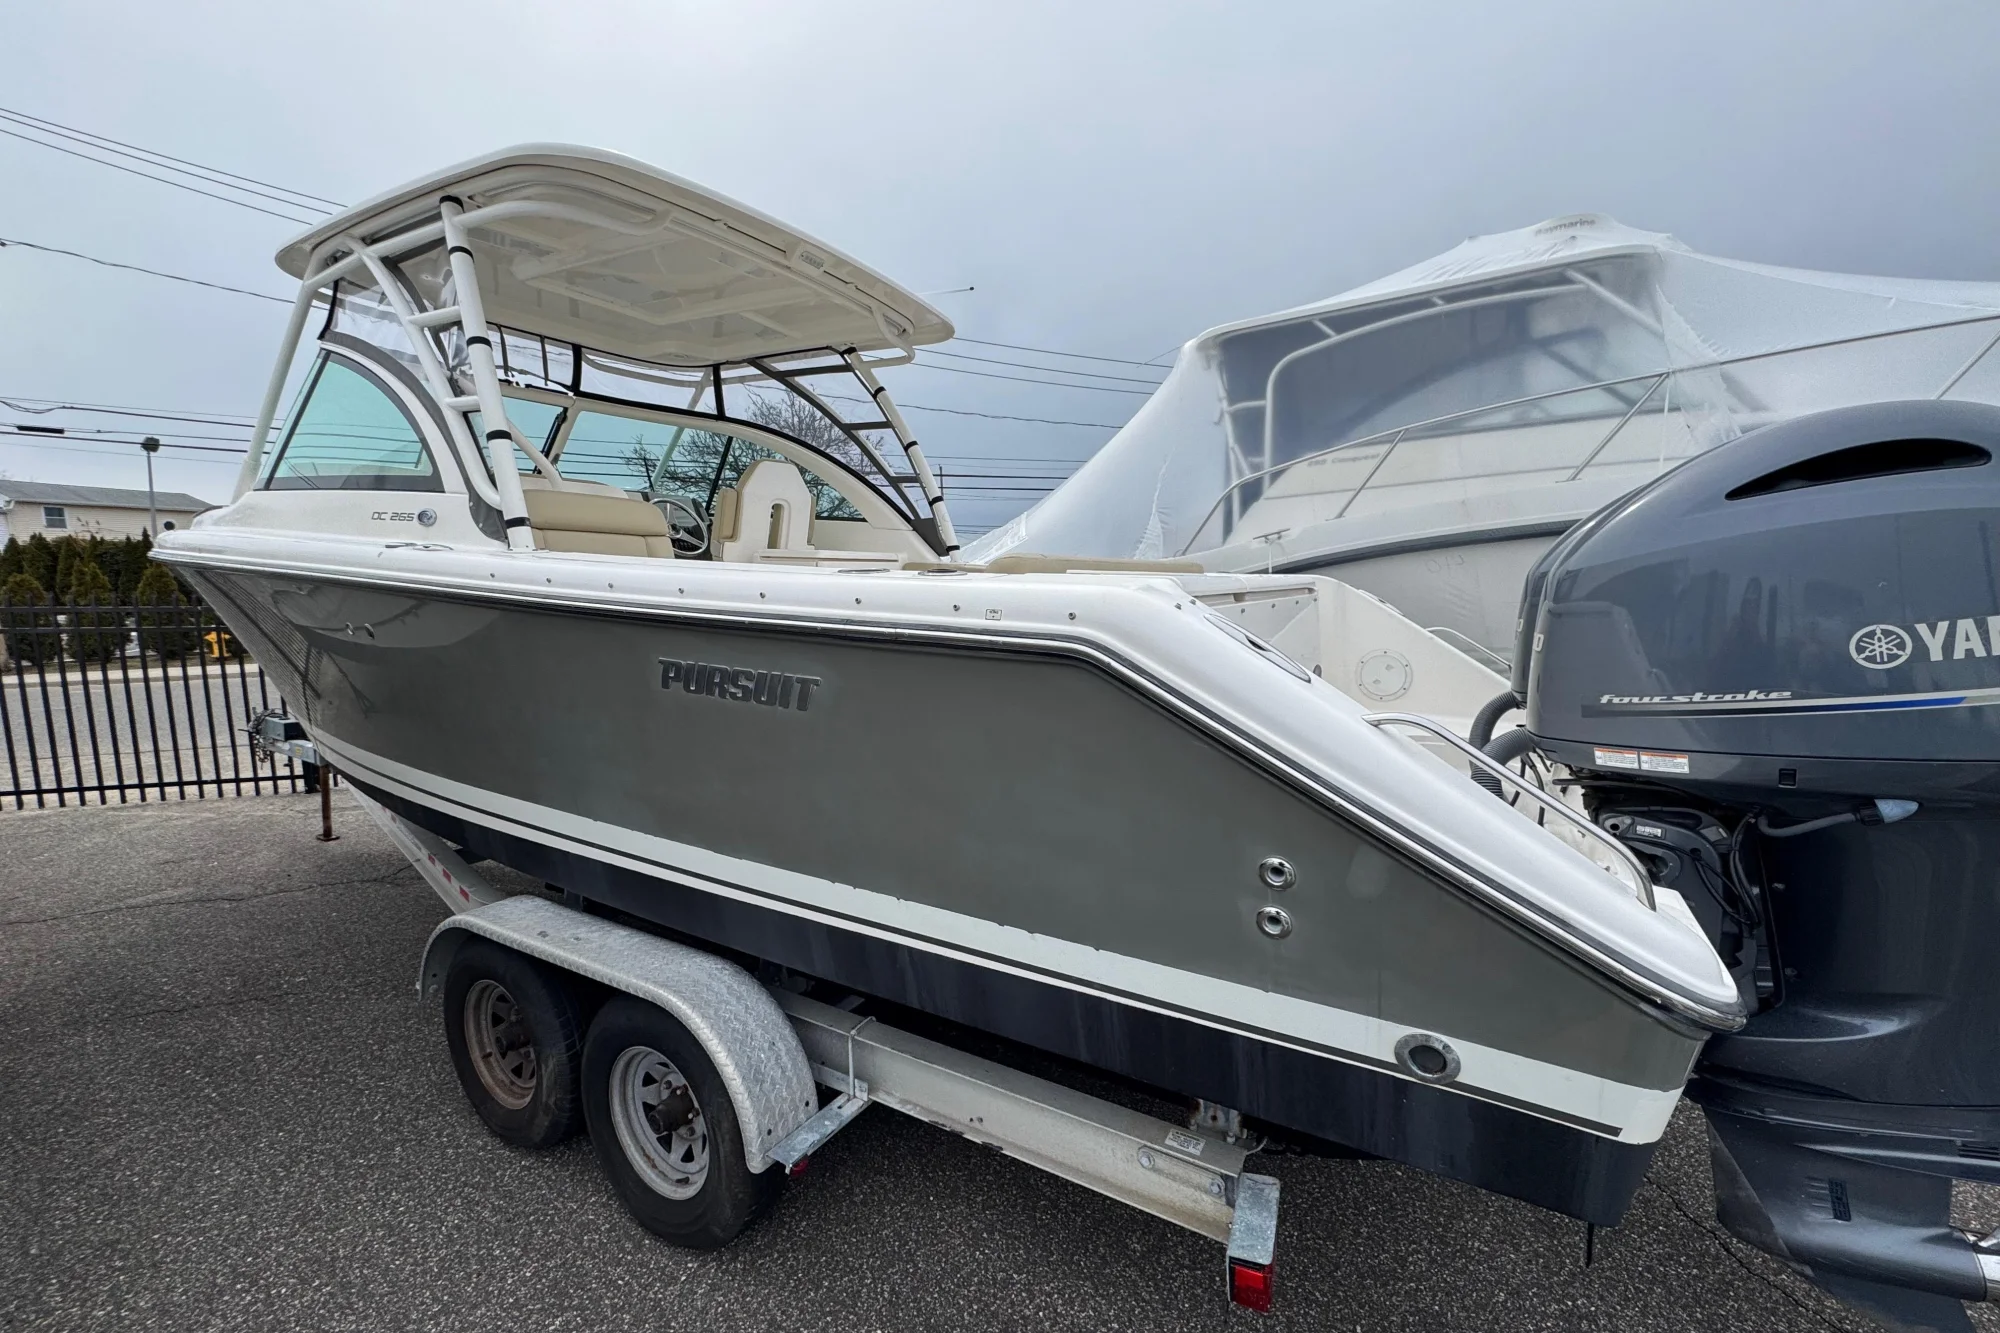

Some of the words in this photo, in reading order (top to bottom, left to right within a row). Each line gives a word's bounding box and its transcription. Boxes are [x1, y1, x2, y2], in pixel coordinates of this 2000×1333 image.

[371, 511, 388, 521] DC
[390, 512, 415, 522] 265
[658, 656, 822, 712] PURSUIT
